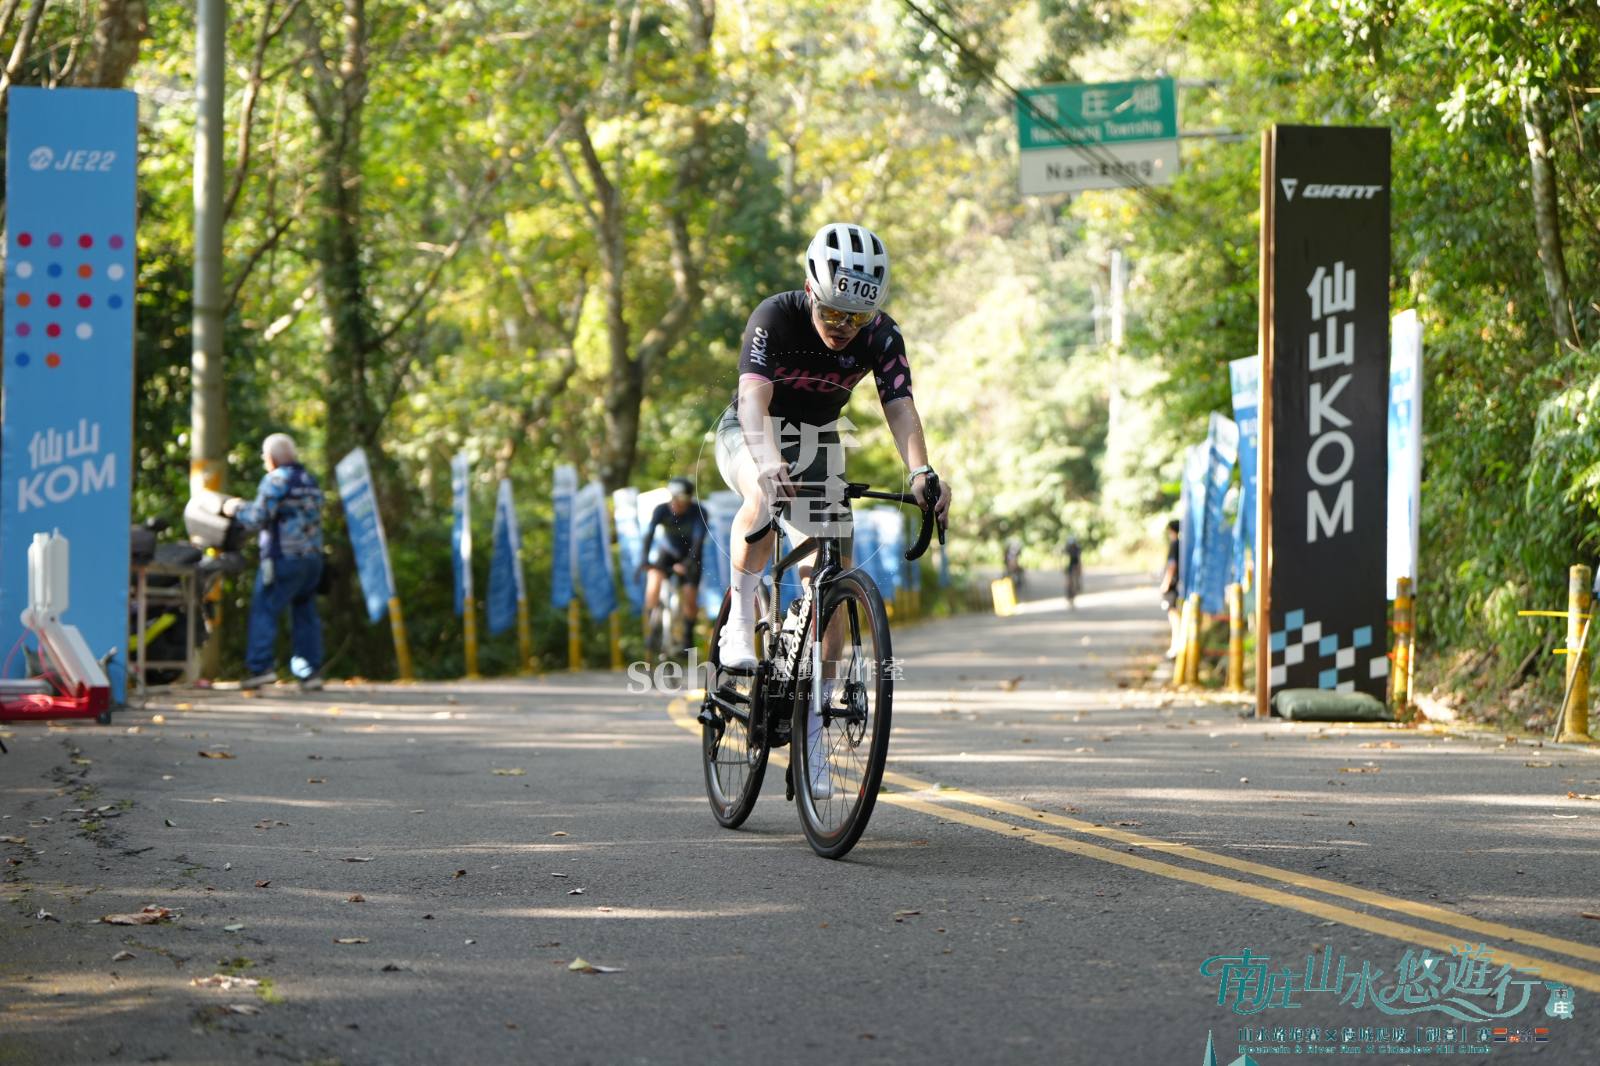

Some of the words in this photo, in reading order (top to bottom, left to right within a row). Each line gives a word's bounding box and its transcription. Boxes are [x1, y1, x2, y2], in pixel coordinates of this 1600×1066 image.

[1103, 119, 1164, 137] Township
[54, 149, 117, 172] JE22
[1302, 184, 1384, 200] GIANT
[750, 326, 769, 367] HKCC
[28, 418, 99, 470] 仙山
[17, 453, 117, 512] KOM
